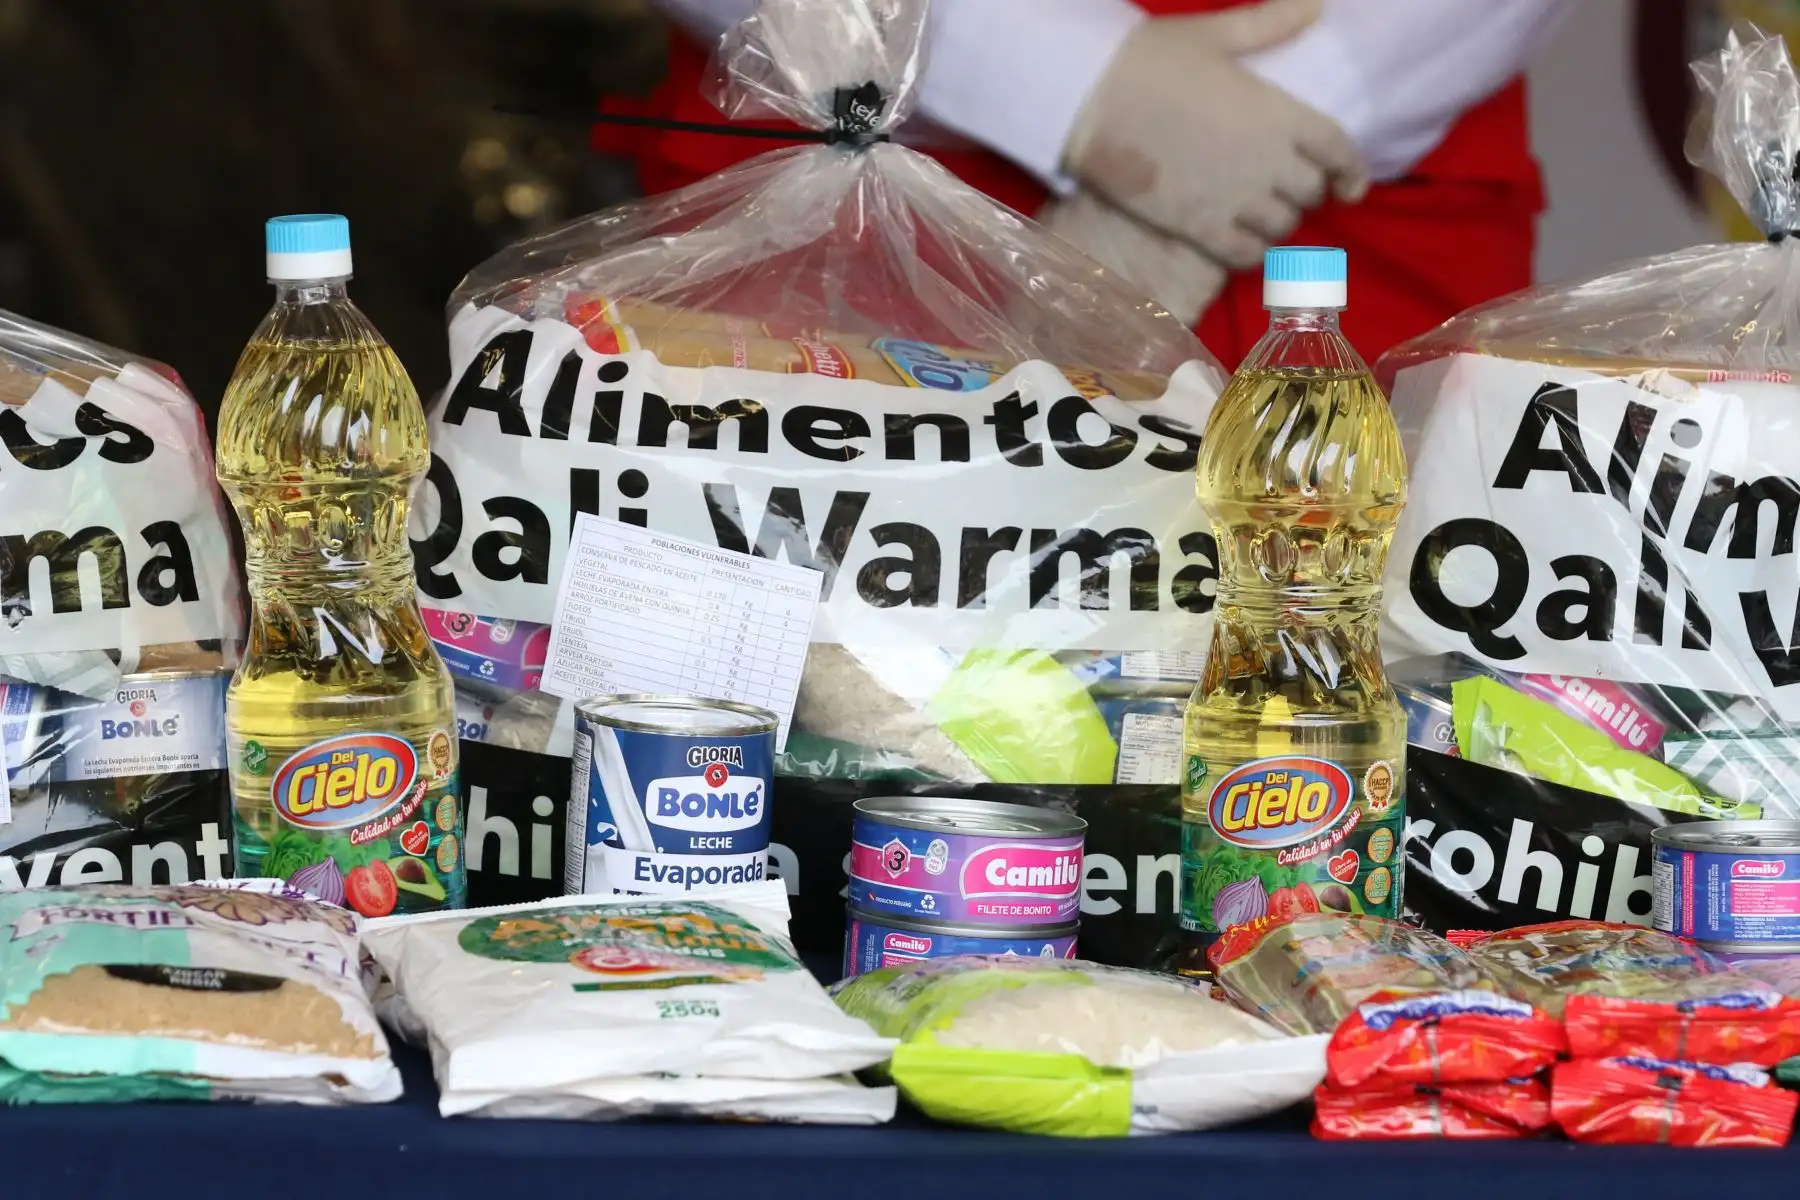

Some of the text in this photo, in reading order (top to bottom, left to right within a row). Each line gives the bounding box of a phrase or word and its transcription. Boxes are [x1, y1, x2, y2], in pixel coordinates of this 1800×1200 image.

[442, 328, 1202, 472] Alimentos
[581, 546, 618, 561] CONSERVA
[629, 557, 662, 573] PESCADO
[623, 545, 663, 561] PRODUCTO
[651, 538, 751, 570] POBLACIONES VULNERABLES
[579, 558, 608, 571] VEGETAL
[575, 569, 597, 580] LECHE
[570, 591, 594, 602] ARROZ
[561, 637, 588, 651] LENTEJA
[554, 670, 576, 681] ACEITE
[116, 688, 158, 705] GLORIA
[331, 751, 354, 766] Del
[687, 746, 744, 769] GLORIA
[288, 753, 398, 816] Cielo
[1266, 772, 1288, 786] Del
[351, 817, 391, 844] Calidad
[391, 812, 403, 829] en
[411, 779, 428, 813] mesa
[1222, 776, 1331, 832] Cielo
[690, 837, 733, 849] LECHE
[1278, 845, 1319, 865] Calidad
[1320, 838, 1333, 852] en
[1343, 808, 1361, 838] mesa
[889, 850, 906, 871] 3
[634, 856, 763, 891] Evaporada
[985, 856, 1078, 887] Camilú
[1738, 864, 1779, 874] Camilú
[977, 904, 1008, 915] FILETE
[1010, 905, 1022, 915] DE
[1023, 905, 1052, 916] BONITO
[889, 937, 925, 951] Camilú
